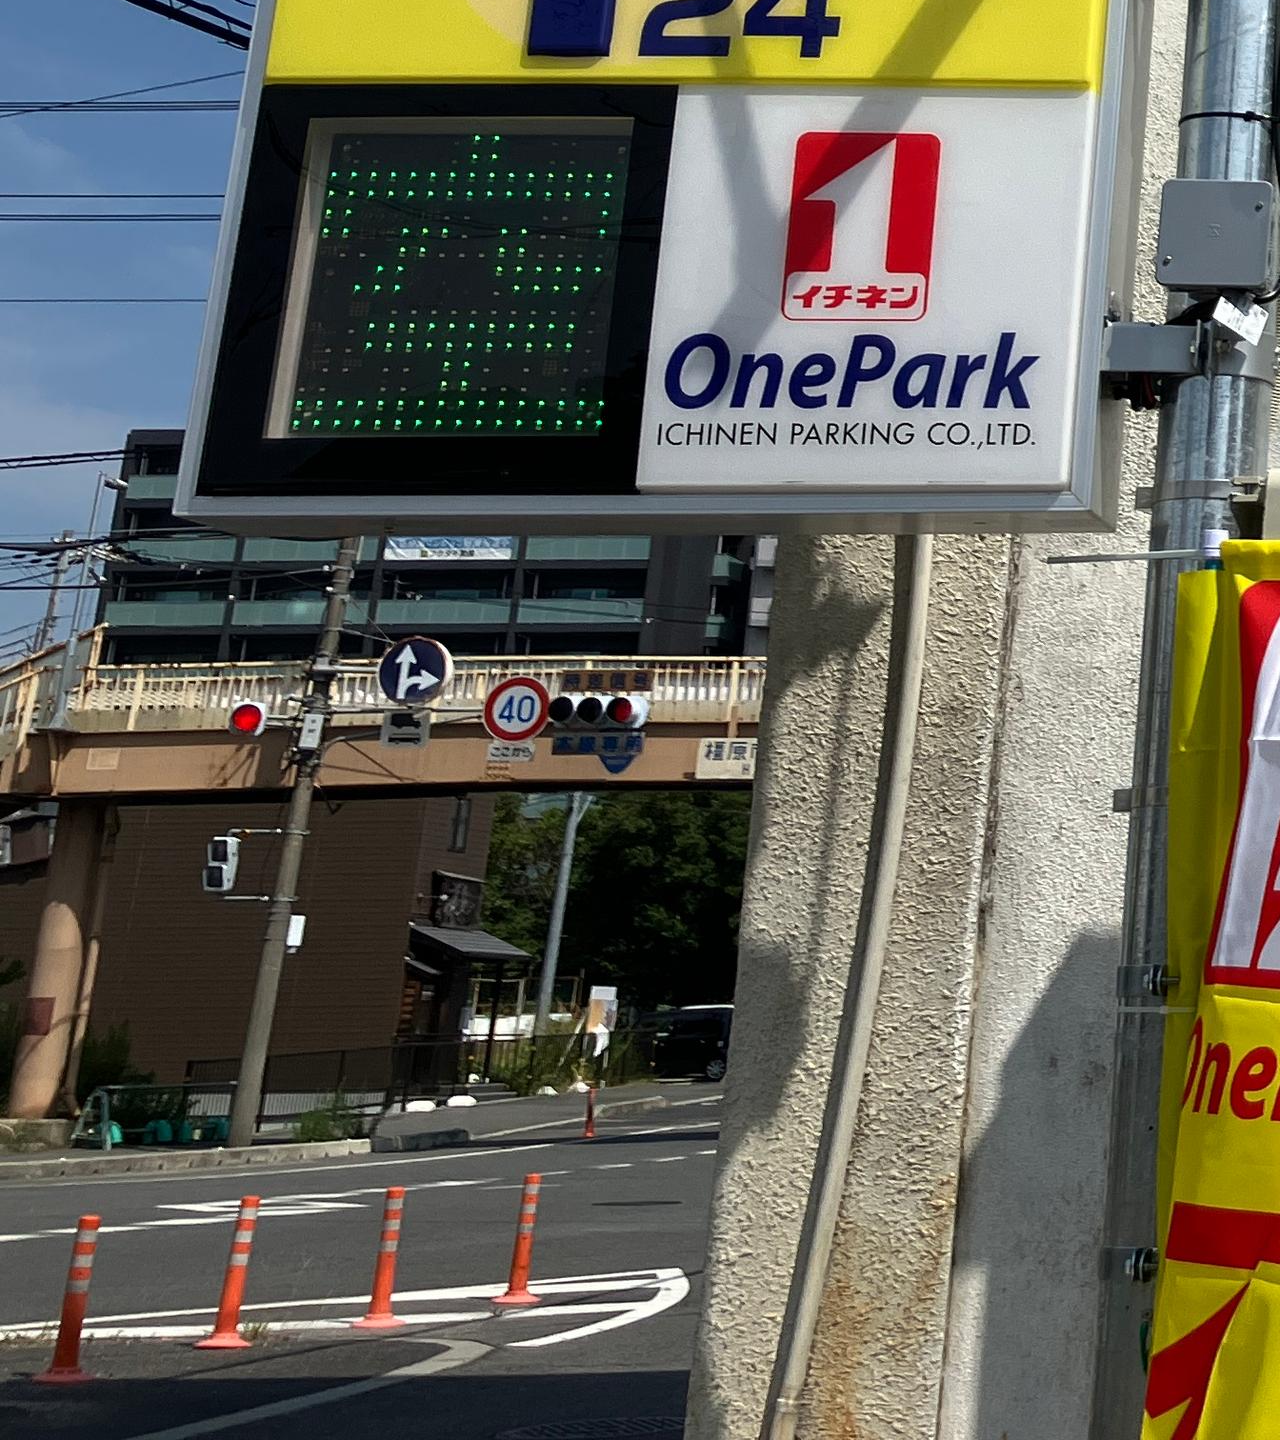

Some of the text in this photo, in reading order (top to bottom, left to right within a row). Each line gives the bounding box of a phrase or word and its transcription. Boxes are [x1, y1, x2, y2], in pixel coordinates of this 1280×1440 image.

[792, 282, 920, 310] イチネン
[664, 331, 1041, 410] OnePark
[655, 422, 1037, 451] ICHINEN PARKING CO.,LTD.
[499, 694, 536, 724] 40
